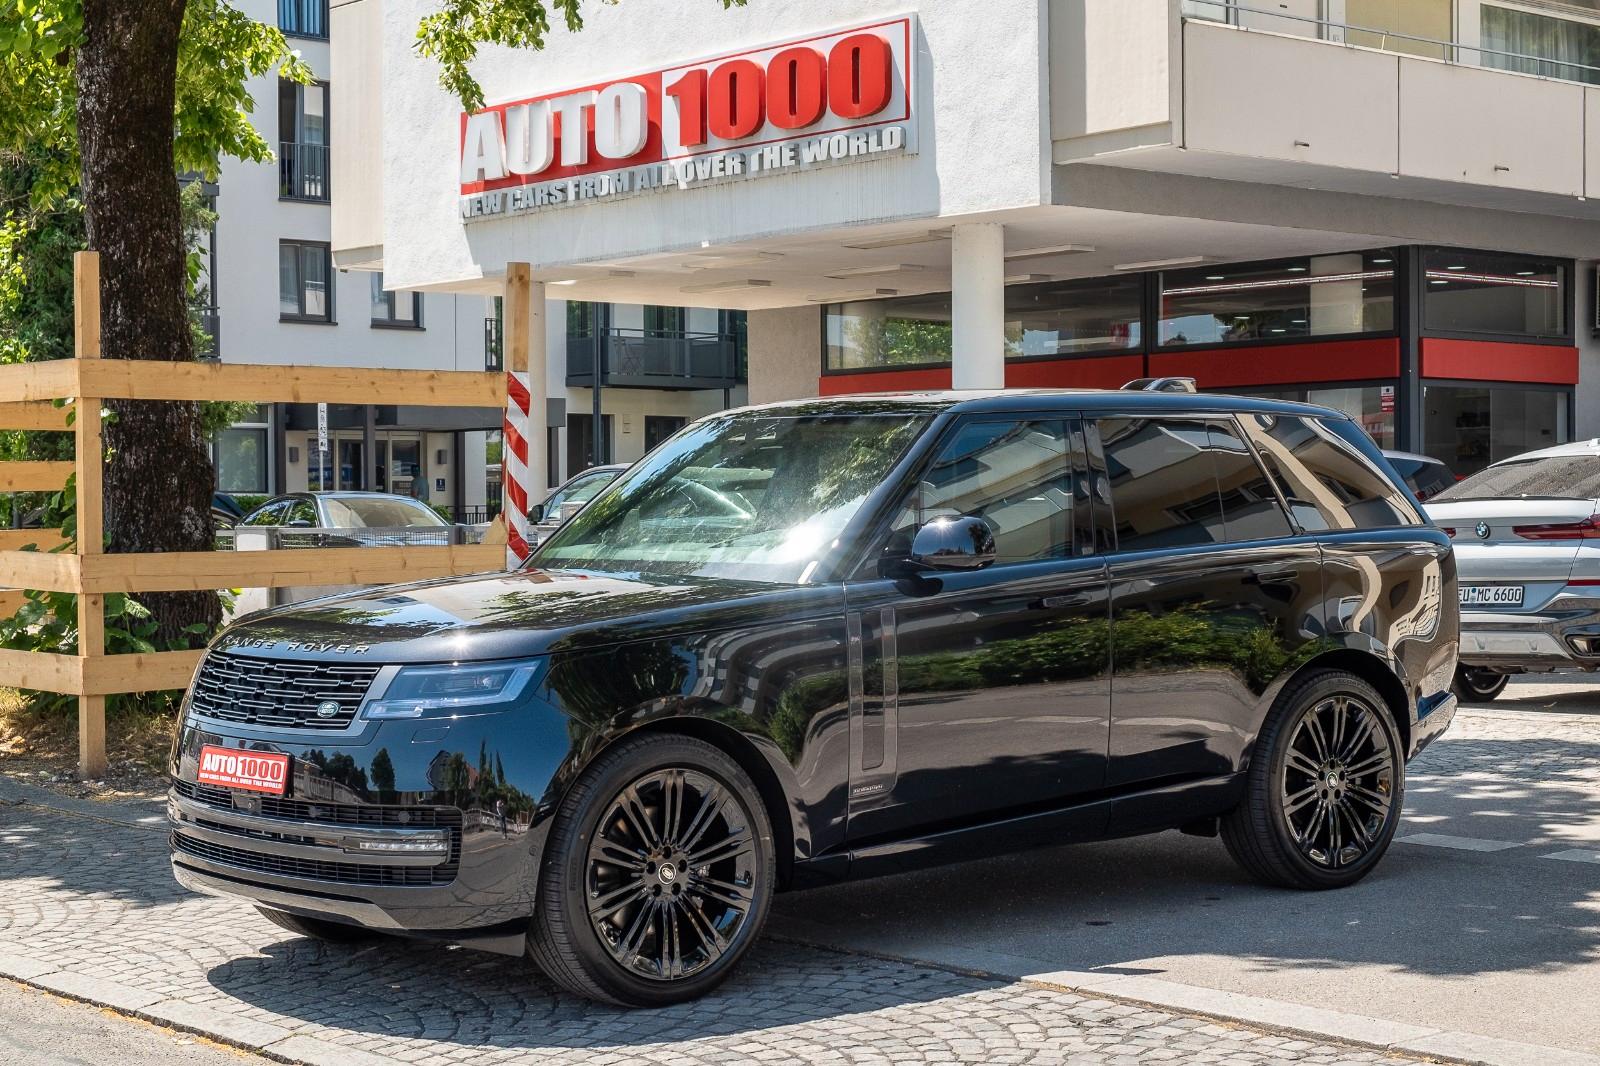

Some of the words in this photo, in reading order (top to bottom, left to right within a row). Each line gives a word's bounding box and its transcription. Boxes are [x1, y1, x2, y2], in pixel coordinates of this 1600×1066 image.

[460, 81, 648, 184] AUTO
[665, 33, 893, 147] 1000
[460, 190, 499, 217] NEW
[506, 182, 566, 211] CARS
[567, 173, 629, 201] FROM
[634, 162, 677, 191] ALL
[678, 152, 745, 185] OVER
[751, 144, 798, 171] THE
[803, 126, 906, 163] WORLD
[1477, 588, 1491, 601] MC
[1493, 587, 1522, 601] 6600
[223, 634, 277, 649] RANGE
[287, 640, 370, 655] ROVER
[202, 753, 237, 775] AUTO
[239, 758, 282, 780] 1000
